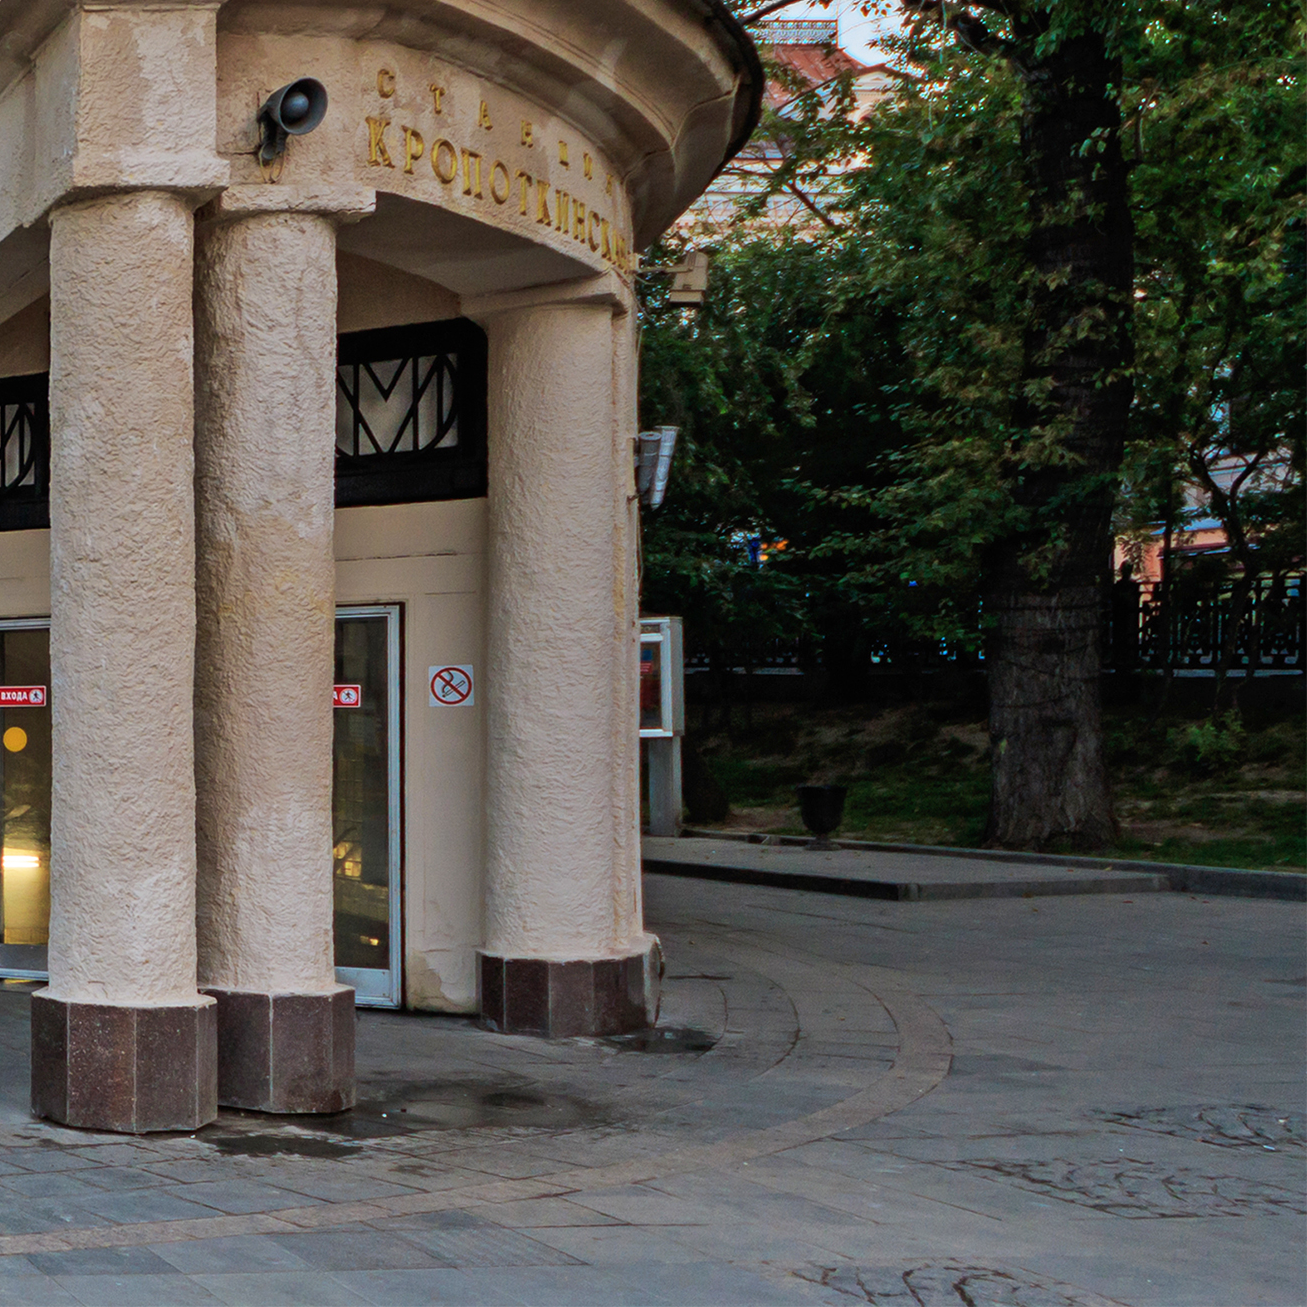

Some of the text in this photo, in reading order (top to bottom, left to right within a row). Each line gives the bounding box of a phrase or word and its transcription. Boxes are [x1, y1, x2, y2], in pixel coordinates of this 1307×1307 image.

[365, 115, 629, 275] КРОПОТКИНСКАЯ
[376, 68, 613, 197] СТАНЦИЯ
[1, 691, 28, 702] ВХОДА
